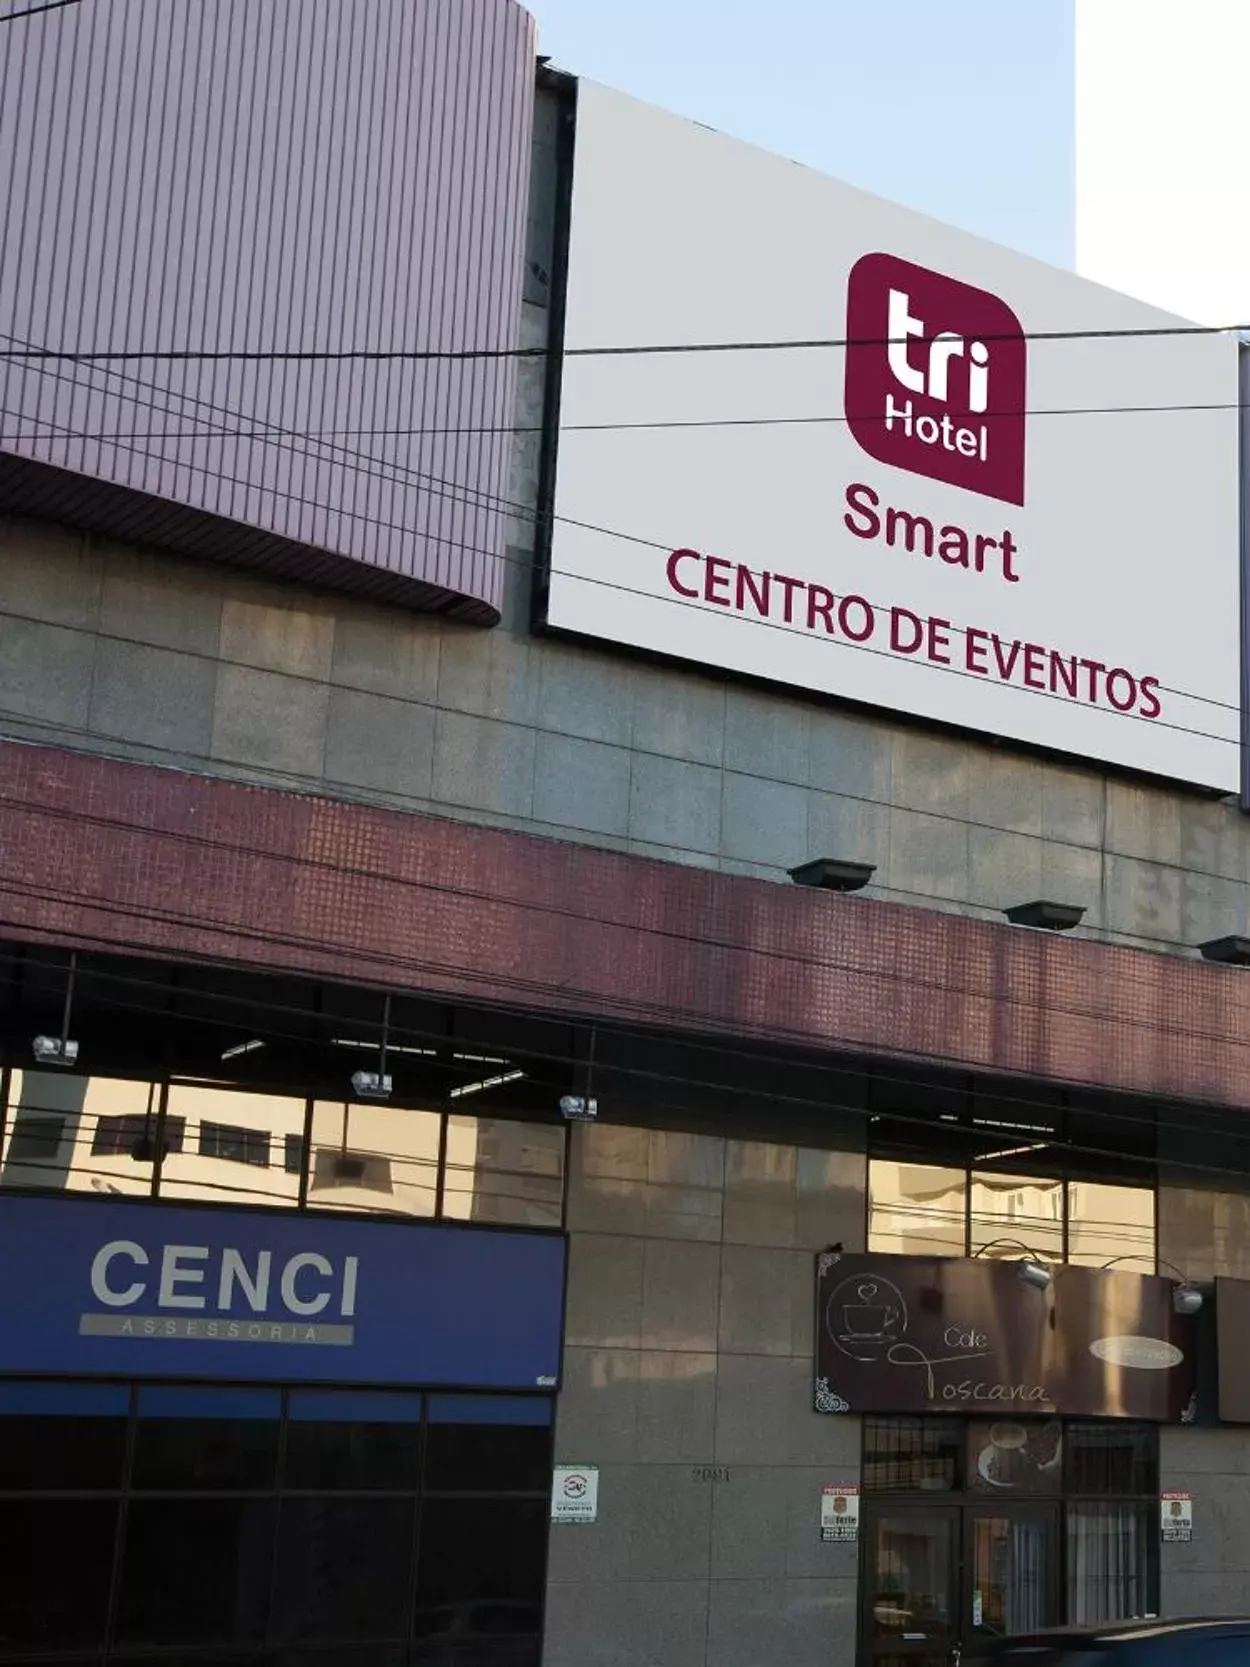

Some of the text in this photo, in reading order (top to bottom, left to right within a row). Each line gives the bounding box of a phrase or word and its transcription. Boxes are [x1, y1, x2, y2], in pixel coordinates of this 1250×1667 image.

[887, 287, 989, 413] tri
[884, 393, 988, 463] Hotel
[844, 483, 1020, 583] Smart
[665, 548, 1163, 719] CENTRO DE EVENTOS
[91, 1240, 359, 1317] CENCI
[120, 1318, 320, 1342] ASSESSORIA
